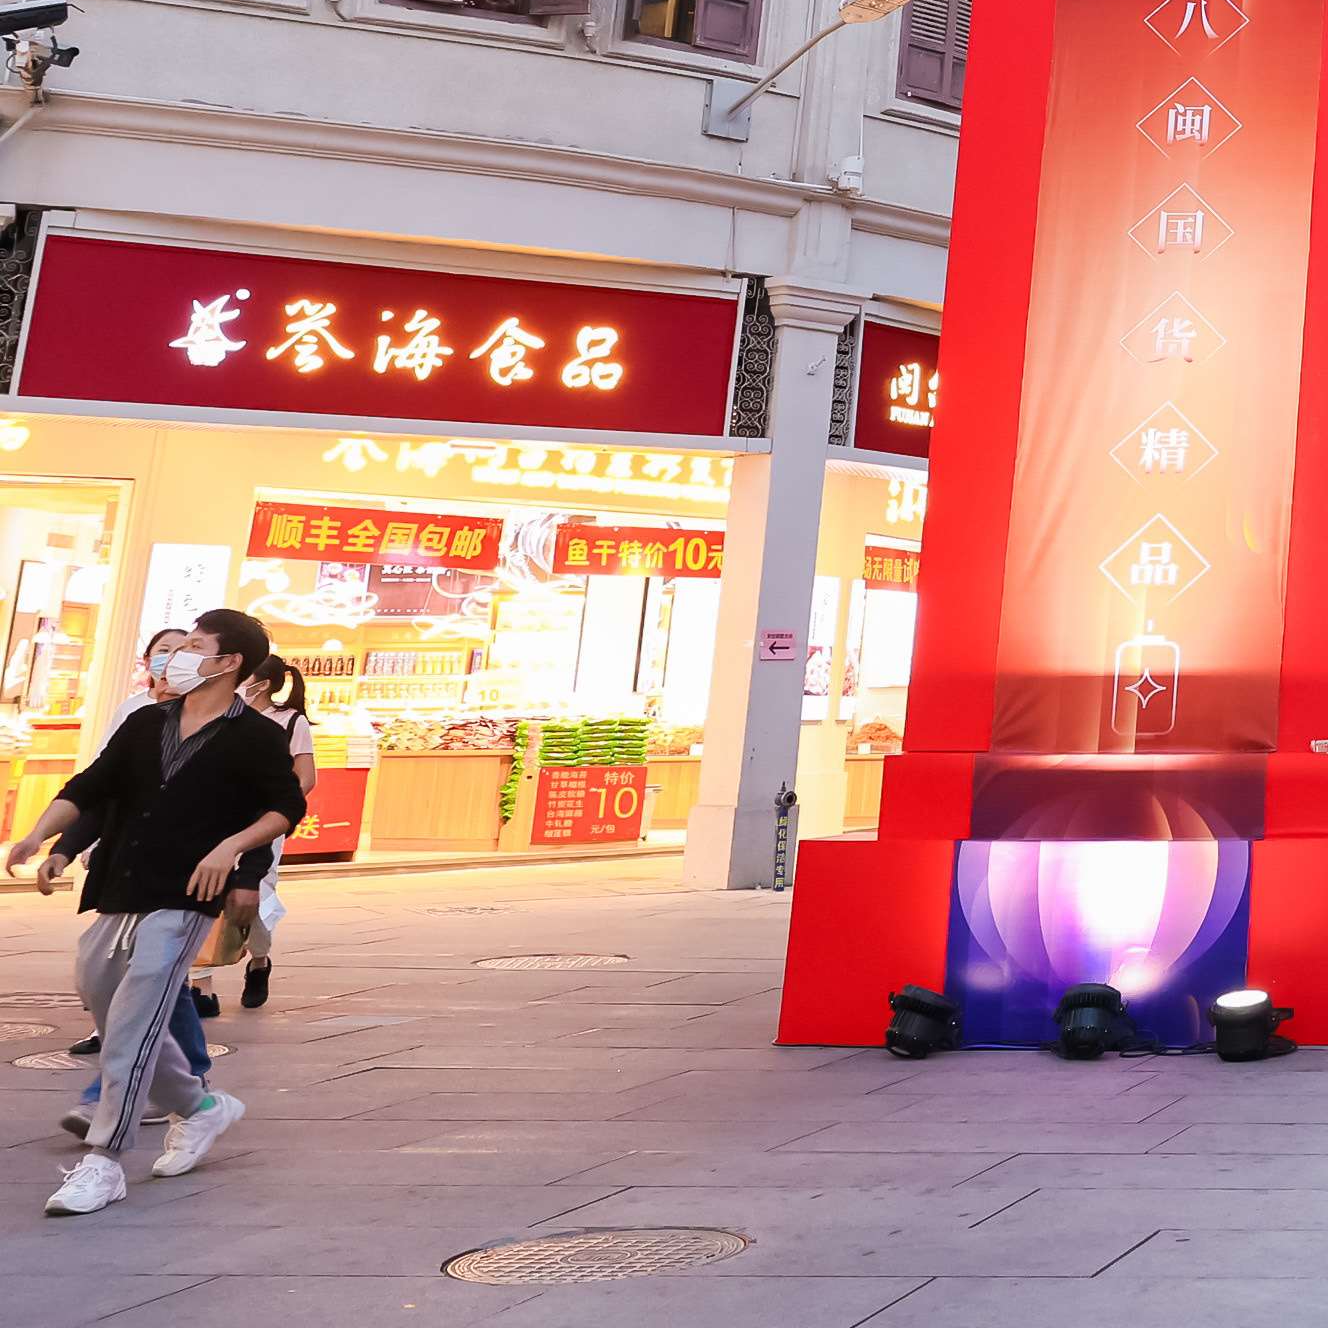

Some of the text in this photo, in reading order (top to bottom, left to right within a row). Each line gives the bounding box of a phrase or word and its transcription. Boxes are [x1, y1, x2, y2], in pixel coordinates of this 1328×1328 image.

[266, 299, 624, 390] 誉海食品
[265, 513, 488, 560] 顺丰全国包邮
[604, 771, 635, 785] 特价
[589, 787, 639, 819] 10
